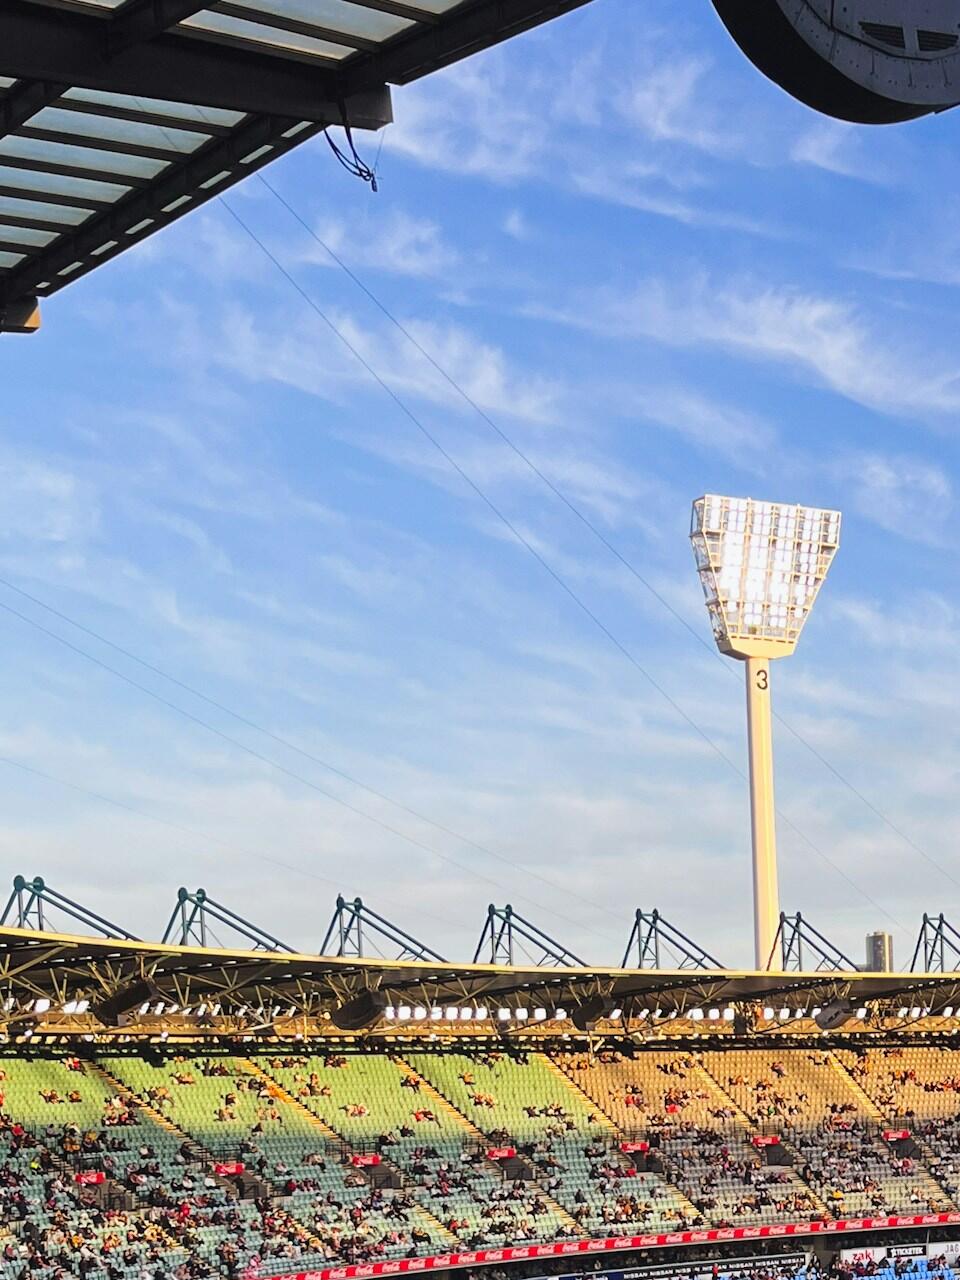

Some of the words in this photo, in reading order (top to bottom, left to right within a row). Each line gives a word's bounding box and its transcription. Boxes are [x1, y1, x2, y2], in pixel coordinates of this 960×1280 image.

[756, 670, 768, 690] 3
[781, 1257, 804, 1265] NISSAN
[650, 1269, 673, 1277] NISSAN
[675, 1266, 699, 1274] NISSN
